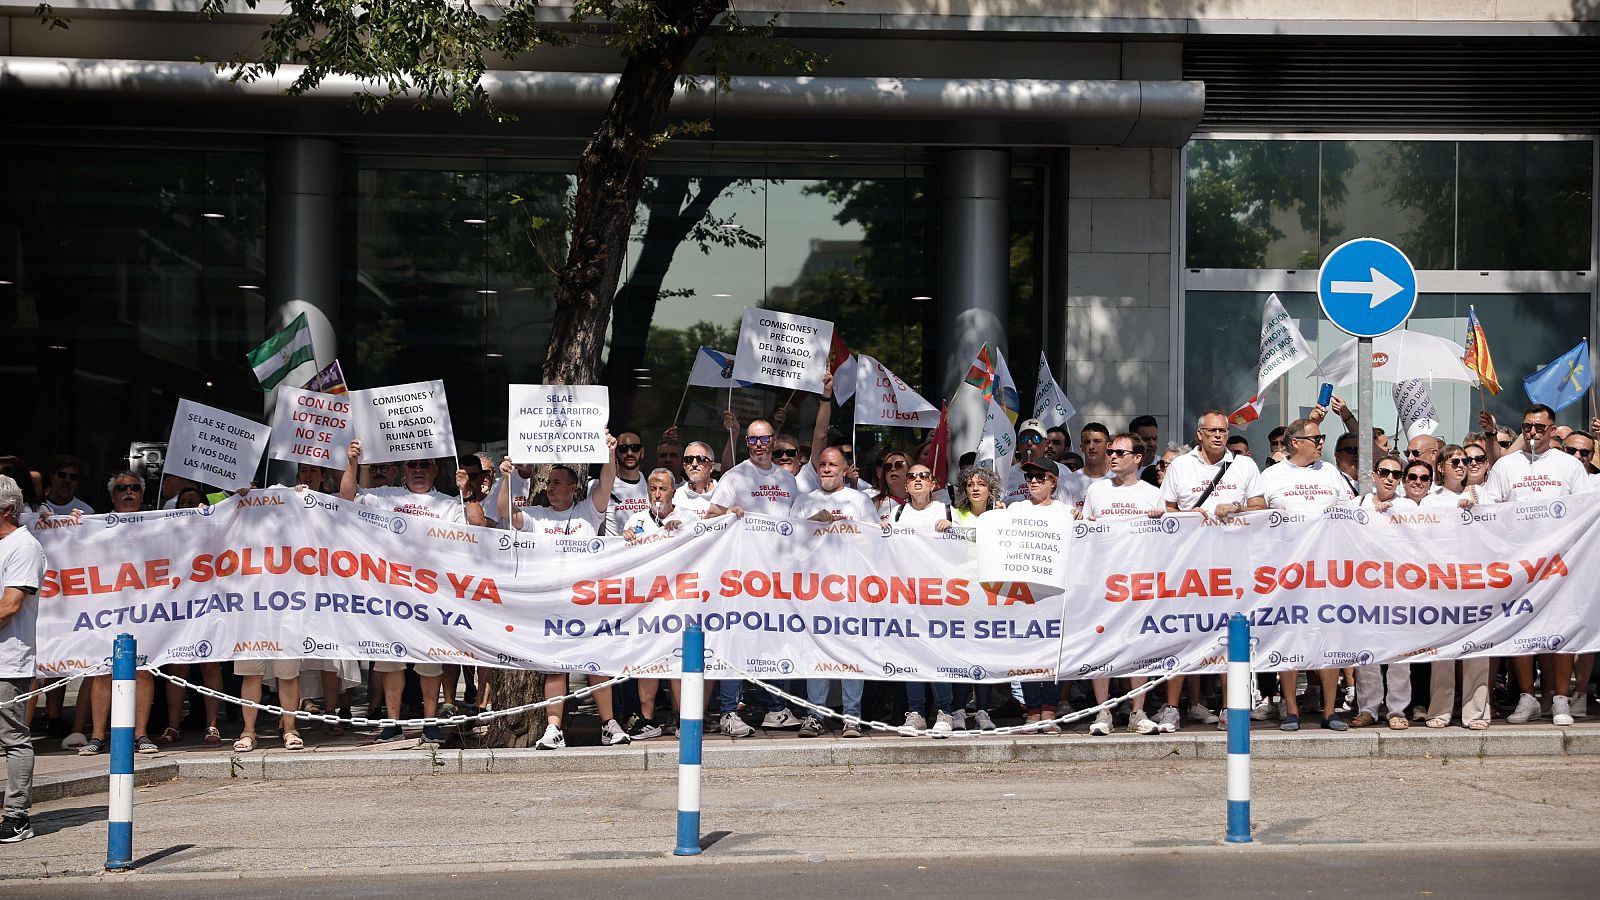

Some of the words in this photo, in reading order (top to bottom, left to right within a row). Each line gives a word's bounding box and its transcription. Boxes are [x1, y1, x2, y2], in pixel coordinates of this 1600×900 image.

[759, 318, 812, 334] COMISIONES
[770, 332, 805, 345] PRECIOS
[758, 342, 774, 352] DEL
[775, 345, 812, 359] PASADO,
[1261, 335, 1294, 364] PODEMOS
[761, 355, 788, 366] RUINA
[790, 360, 806, 369] DEL
[1260, 346, 1298, 380] SOBREVIVIR
[761, 366, 802, 380] PRESENTE
[297, 395, 325, 410] CON
[327, 400, 350, 414] LOS
[372, 393, 427, 407] COMISIONES
[428, 391, 434, 399] Y
[546, 394, 573, 403] SELAE
[387, 405, 424, 416] PRECIOS
[520, 407, 544, 415] HACE
[546, 407, 558, 415] DE
[560, 406, 602, 416] ÁRBITRO,
[881, 409, 919, 421] JUEGA
[1410, 406, 1424, 422] NOS
[292, 410, 347, 429] LOTEROS
[379, 421, 397, 430] DEL
[398, 416, 436, 429] PASADO,
[539, 420, 568, 428] JUEGA
[570, 420, 582, 428] EN
[188, 413, 214, 427] SELAE
[215, 422, 225, 431] SE
[227, 425, 255, 441] QUEDA
[198, 431, 208, 441] EL
[210, 435, 238, 451] PASTEL
[295, 427, 315, 440] NO
[318, 431, 333, 444] SE
[386, 432, 415, 441] RUINA
[417, 429, 434, 438] DEL
[519, 432, 560, 440] NUESTRA
[562, 432, 600, 440] CONTRA
[1002, 432, 1012, 447] SIN
[291, 443, 330, 460] JUEGA
[389, 441, 434, 452] PRESENTE
[526, 445, 532, 453] Y
[534, 445, 554, 453] NOS
[556, 445, 595, 453] EXPULSA
[191, 444, 197, 452] Y
[198, 446, 217, 458] NOS
[218, 452, 237, 466] DEJA
[183, 458, 199, 468] LAS
[200, 462, 237, 481] MIGAJAS
[1512, 481, 1562, 489] SOLUCIONES
[236, 495, 285, 509] ANAPAL
[304, 494, 339, 512] Dedit
[1516, 504, 1549, 514] LOTEROS
[358, 510, 390, 523] LOTEROS
[392, 506, 441, 519] SOLUCIONES
[1268, 511, 1306, 528] Dedit
[1389, 514, 1440, 525] ANAPAL
[1461, 509, 1497, 525] Dedit
[1525, 513, 1549, 521] LUCHA
[105, 513, 144, 528] Dedit
[745, 518, 776, 527] LOTEROS
[1012, 518, 1049, 528] PRECIOS
[1130, 519, 1162, 527] LOTEROS
[427, 527, 479, 545] ANAPAL
[813, 523, 862, 537] ANAPAL
[997, 528, 1004, 536] Y
[1005, 528, 1061, 541] COMISIONES
[1075, 523, 1111, 539] Dedit
[499, 534, 536, 551] Dedit
[999, 540, 1061, 554] COGELADAS,
[563, 546, 587, 554] LUCHA
[1006, 553, 1052, 563] MIENTRAS
[40, 559, 181, 598] SELAE,
[190, 546, 439, 595] SOLUCIONES
[446, 572, 503, 605] YA
[1004, 564, 1030, 572] TODO
[1032, 565, 1054, 576] SUBE
[1104, 568, 1244, 602] SELAE,
[1253, 558, 1513, 595] SOLUCIONES
[1519, 552, 1569, 585] YA
[571, 572, 710, 605] SELAE,
[719, 570, 970, 606] SOLUCIONES
[977, 581, 1036, 606] YA
[73, 592, 244, 632] ACTUALIZAR
[253, 590, 307, 611] LOS
[315, 593, 429, 622] PRECIOS
[438, 608, 473, 630] YA
[1140, 604, 1309, 635] ACTUAIZAR
[1317, 604, 1494, 625] COMISIONES
[1501, 598, 1535, 618] YA
[543, 617, 586, 638] NO
[593, 617, 630, 637] AL
[638, 611, 806, 636] MONOPOLIO
[813, 614, 919, 638] DIGITAL
[928, 619, 968, 639] DE
[974, 618, 1061, 640] SELAE
[233, 640, 283, 653] ANAPAL
[302, 637, 340, 654] Dedit
[358, 640, 390, 649] LOTEROS
[38, 659, 91, 673] ANAPAL
[1201, 655, 1227, 665] ANA
[1268, 650, 1305, 668] Dedit
[813, 662, 864, 673] ANAPAL
[1006, 668, 1056, 678] ANAPAL
